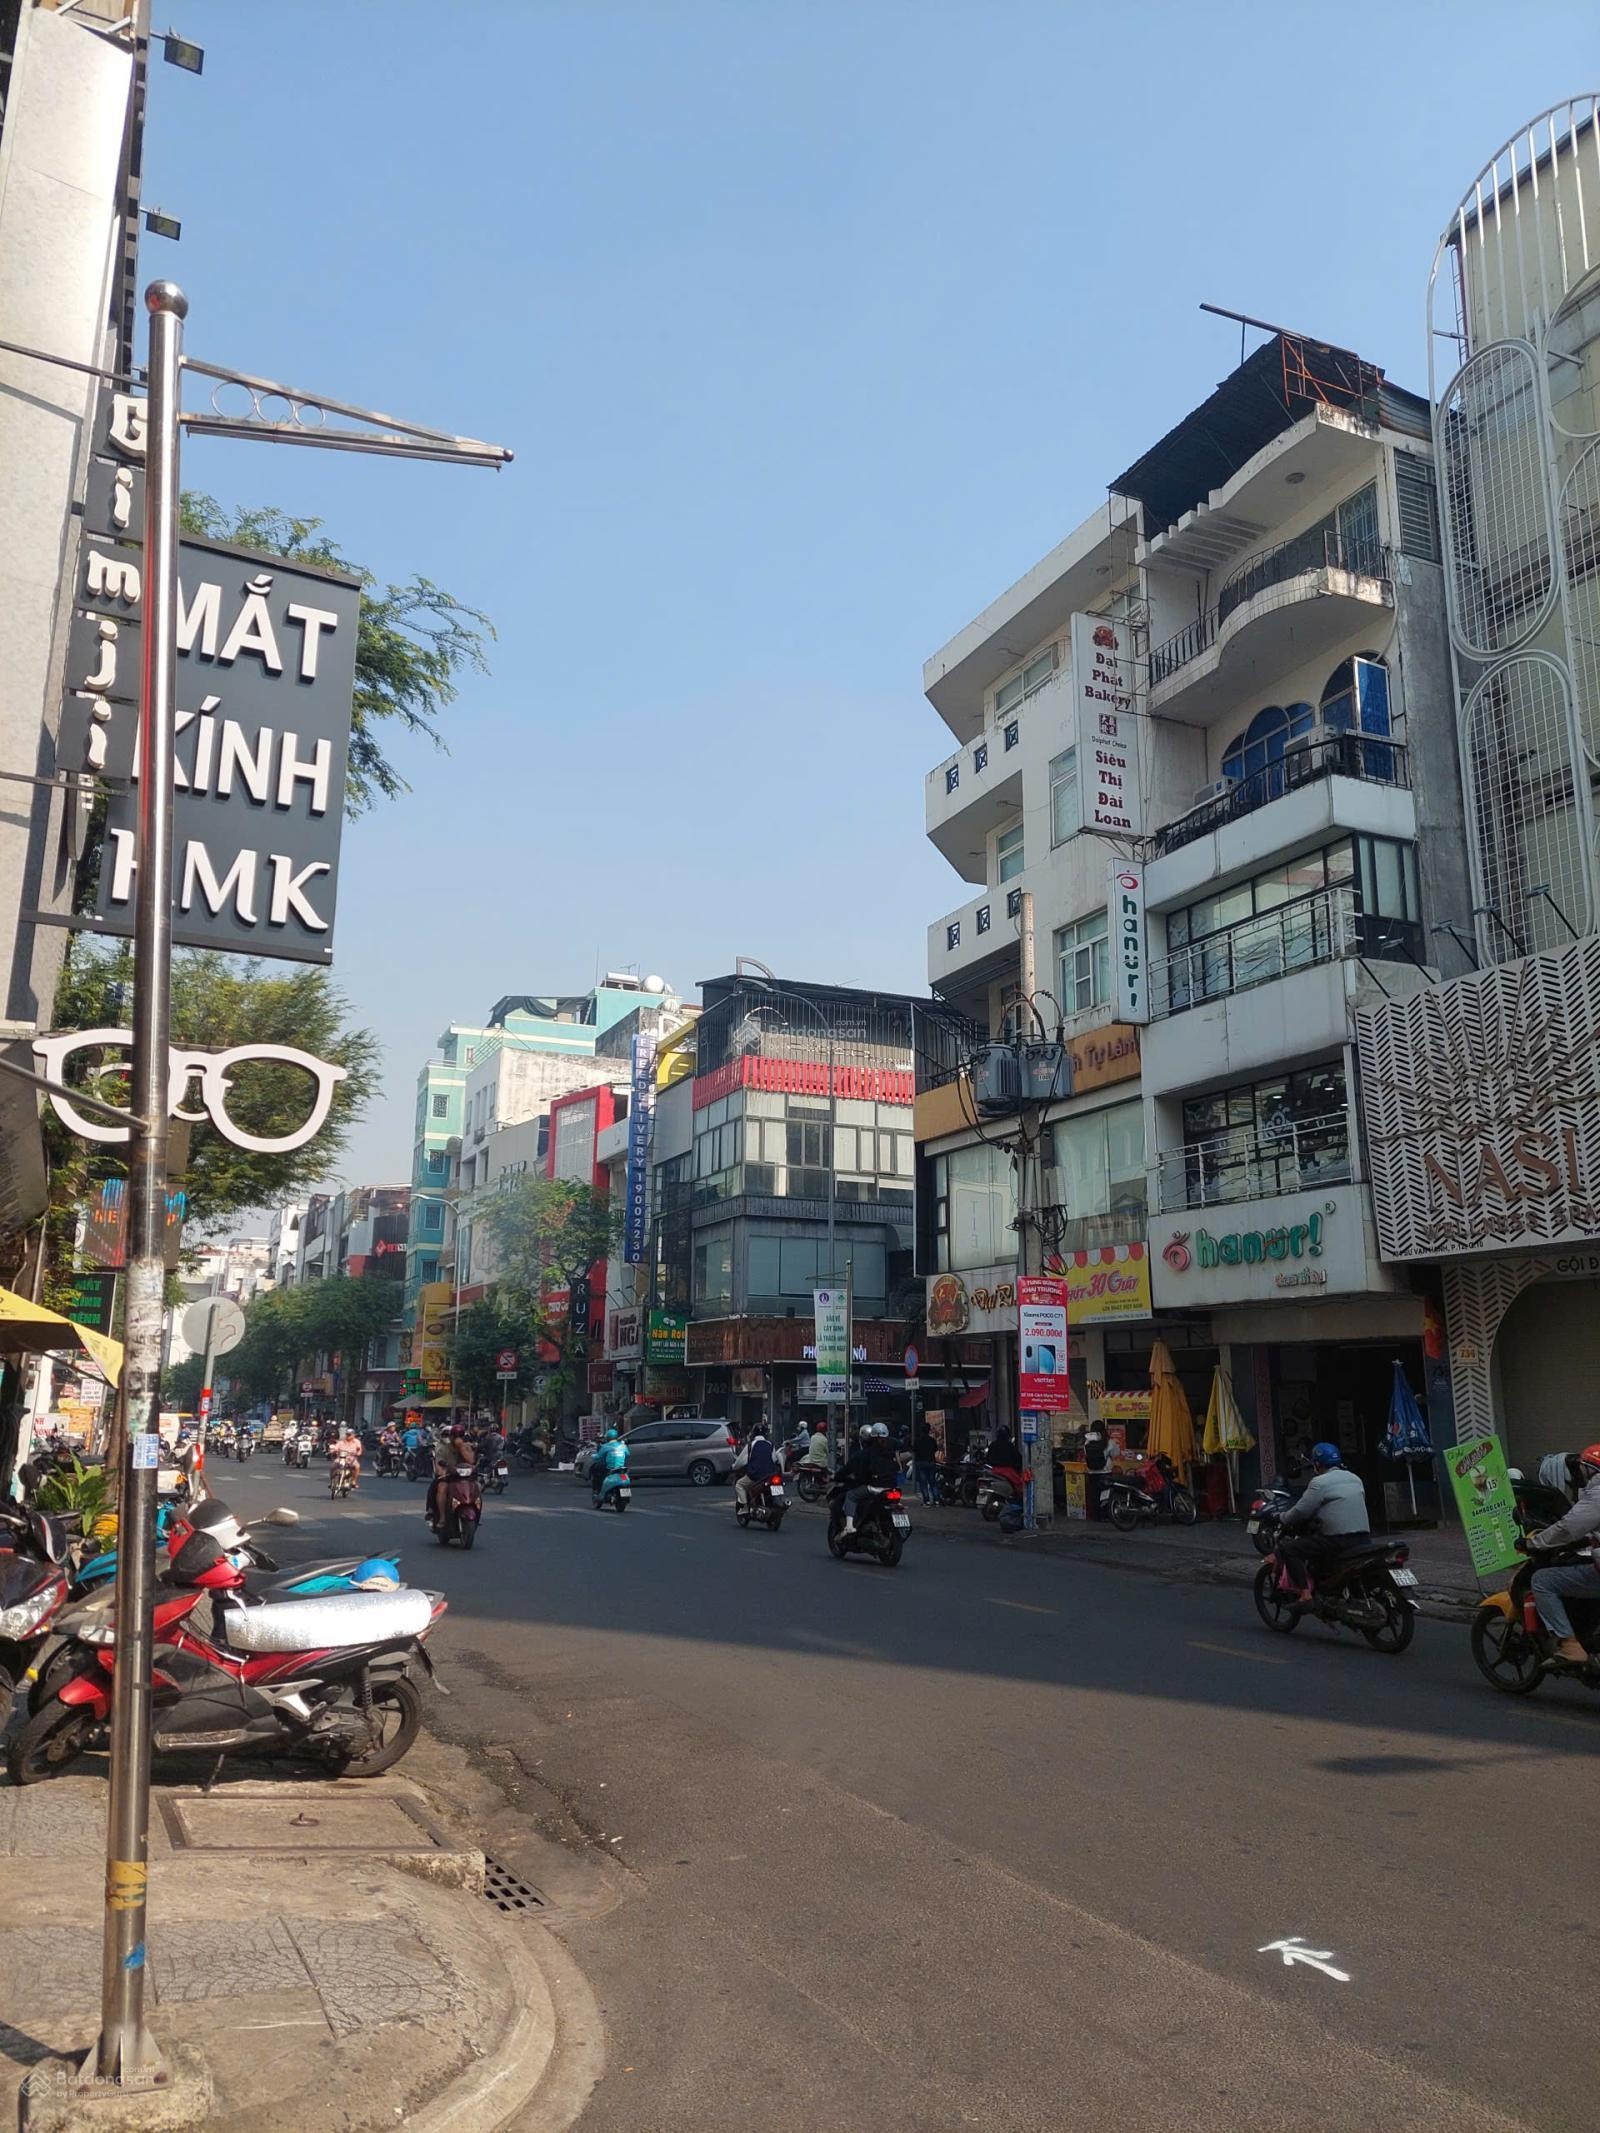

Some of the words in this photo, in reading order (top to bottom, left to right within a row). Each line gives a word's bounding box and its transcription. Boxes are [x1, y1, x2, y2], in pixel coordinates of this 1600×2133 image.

[176, 575, 338, 681] MẮT
[1085, 686, 1131, 710] Bakery
[1095, 750, 1127, 768] Siêu
[1098, 770, 1122, 790] Thị
[1098, 791, 1123, 809] Đài
[1095, 810, 1131, 829] Loan
[1423, 1128, 1584, 1213] NASI
[1424, 1210, 1538, 1240] WELLNESS
[1554, 1203, 1599, 1227] SPA
[1557, 1255, 1584, 1274] GỘI
